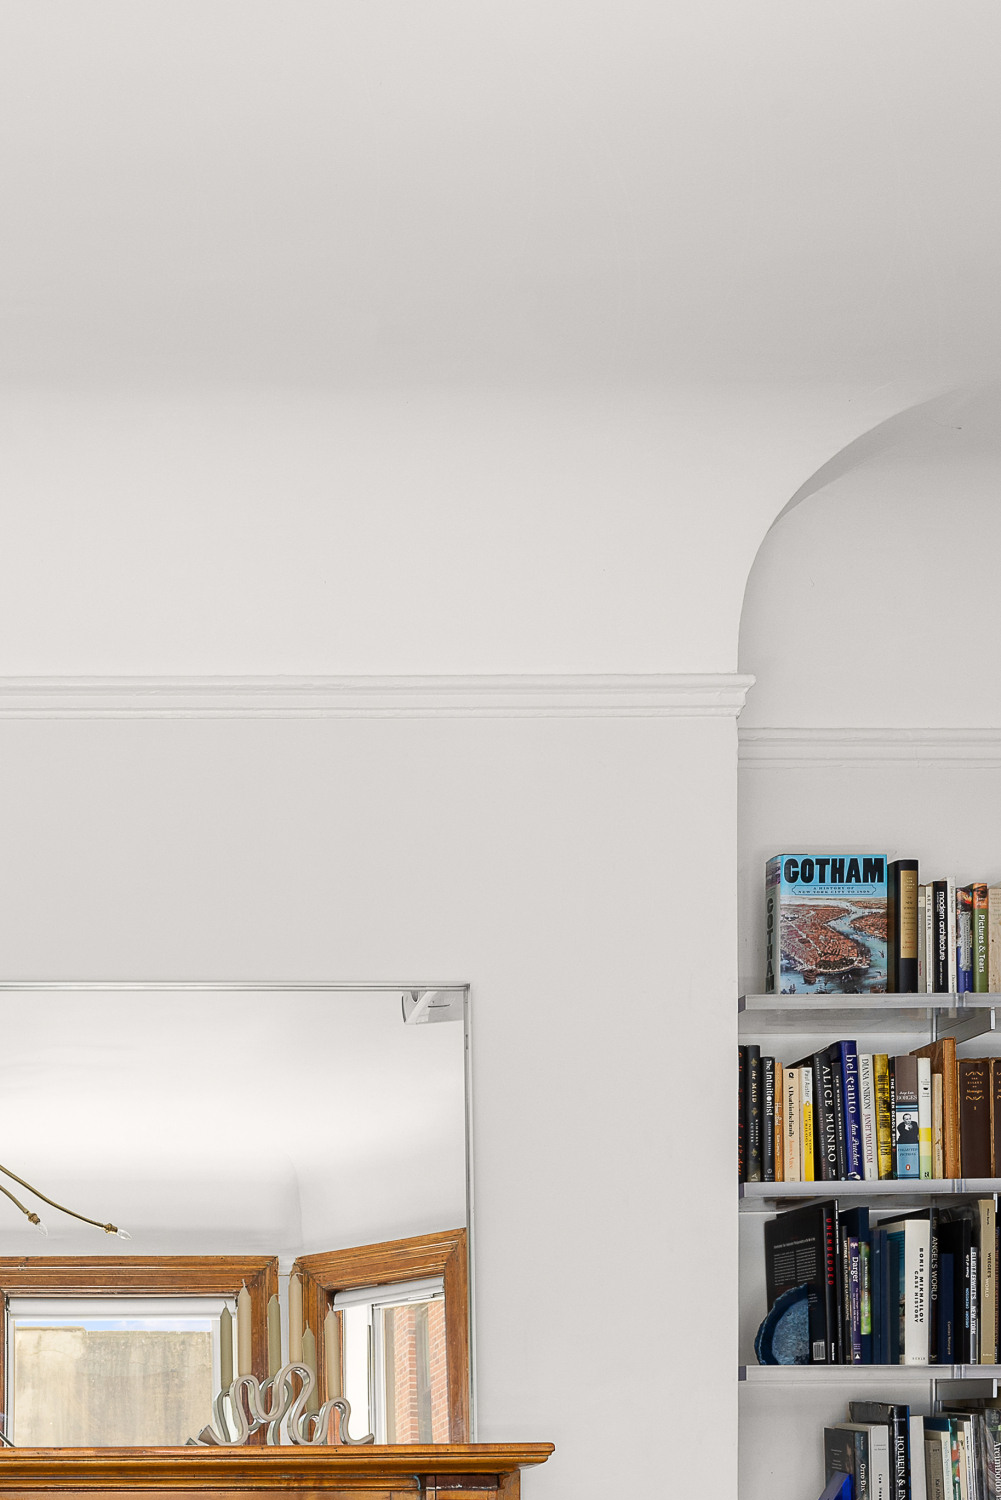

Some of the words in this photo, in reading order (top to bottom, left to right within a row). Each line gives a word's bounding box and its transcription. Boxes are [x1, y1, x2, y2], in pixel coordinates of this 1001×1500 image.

[784, 858, 884, 883] GOTHAM
[766, 898, 774, 992] GOTHAM
[846, 1055, 856, 1073] bel
[822, 1066, 832, 1106] ALICE
[846, 1076, 857, 1114] canto
[826, 1113, 836, 1162] MUNRO
[851, 1257, 859, 1283] Darger
[897, 1436, 905, 1476] HOLBEIN
